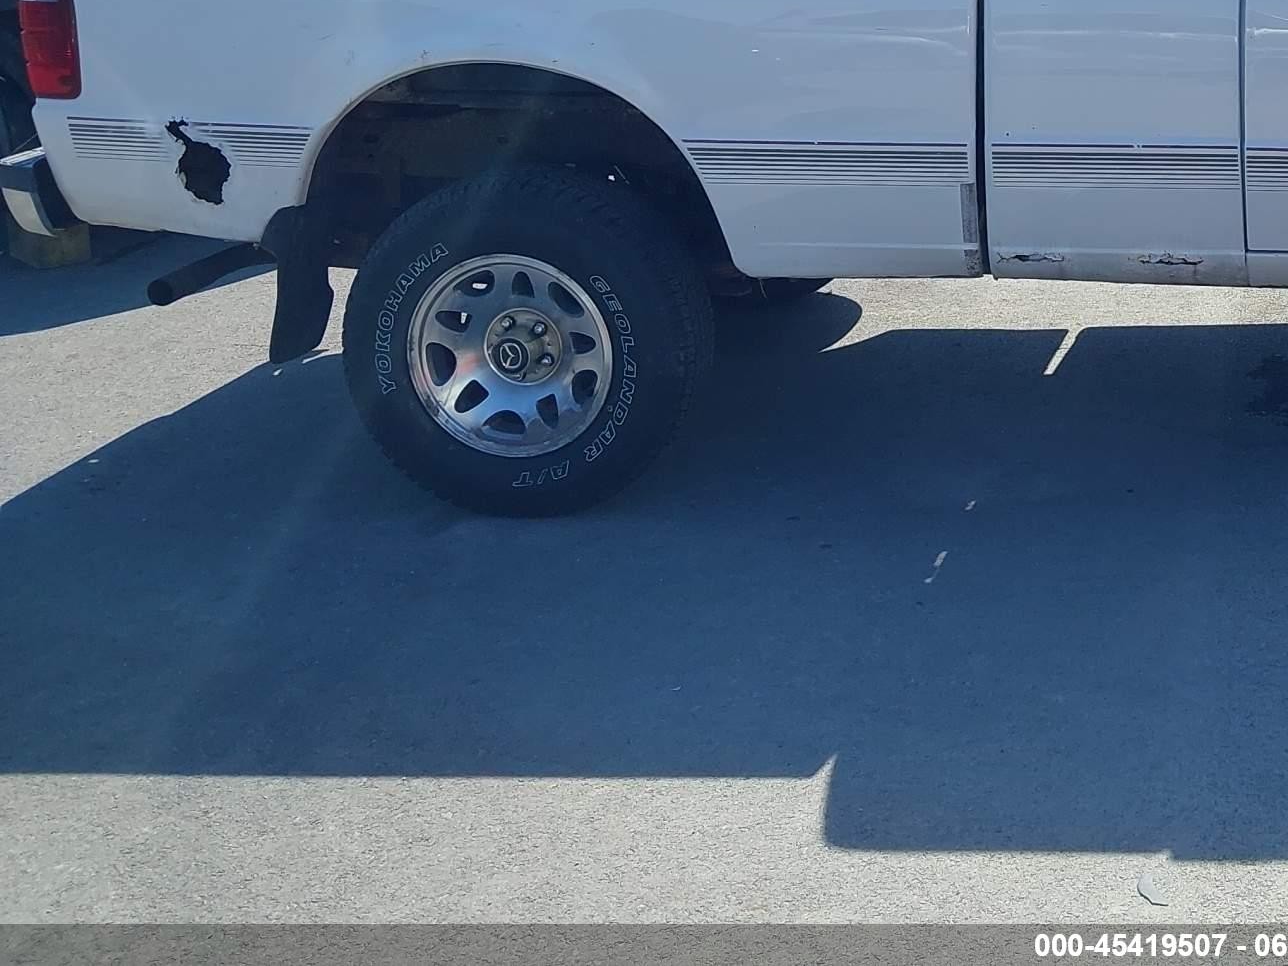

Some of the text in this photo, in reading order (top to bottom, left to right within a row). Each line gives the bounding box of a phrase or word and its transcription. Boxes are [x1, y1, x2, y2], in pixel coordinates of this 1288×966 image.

[374, 242, 449, 394] YOKOHAMA
[512, 275, 637, 487] GEOLANDAR A/T
